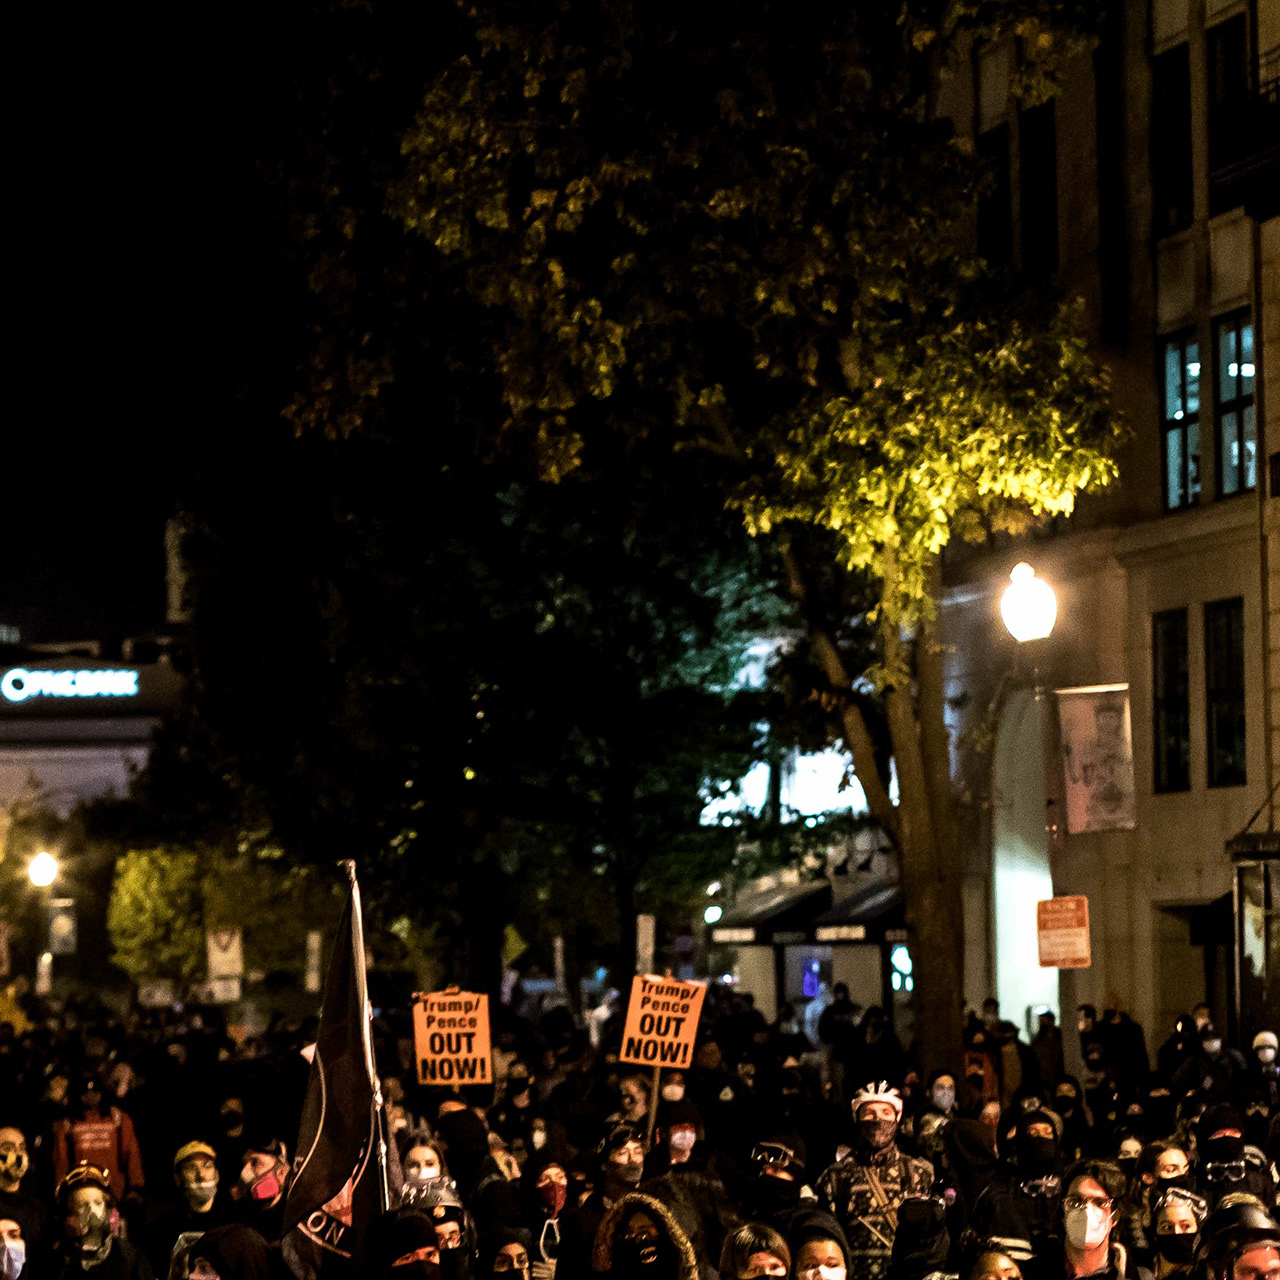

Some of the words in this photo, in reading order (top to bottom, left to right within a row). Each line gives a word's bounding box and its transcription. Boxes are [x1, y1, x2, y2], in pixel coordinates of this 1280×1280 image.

[640, 979, 700, 1000] Trump/
[422, 998, 480, 1015] Trump/
[640, 996, 691, 1014] Pence
[426, 1014, 478, 1030] Pence
[639, 1013, 686, 1038] OUT
[429, 1031, 476, 1055] OUT
[624, 1037, 689, 1065] NOW!
[421, 1057, 487, 1081] NOW!
